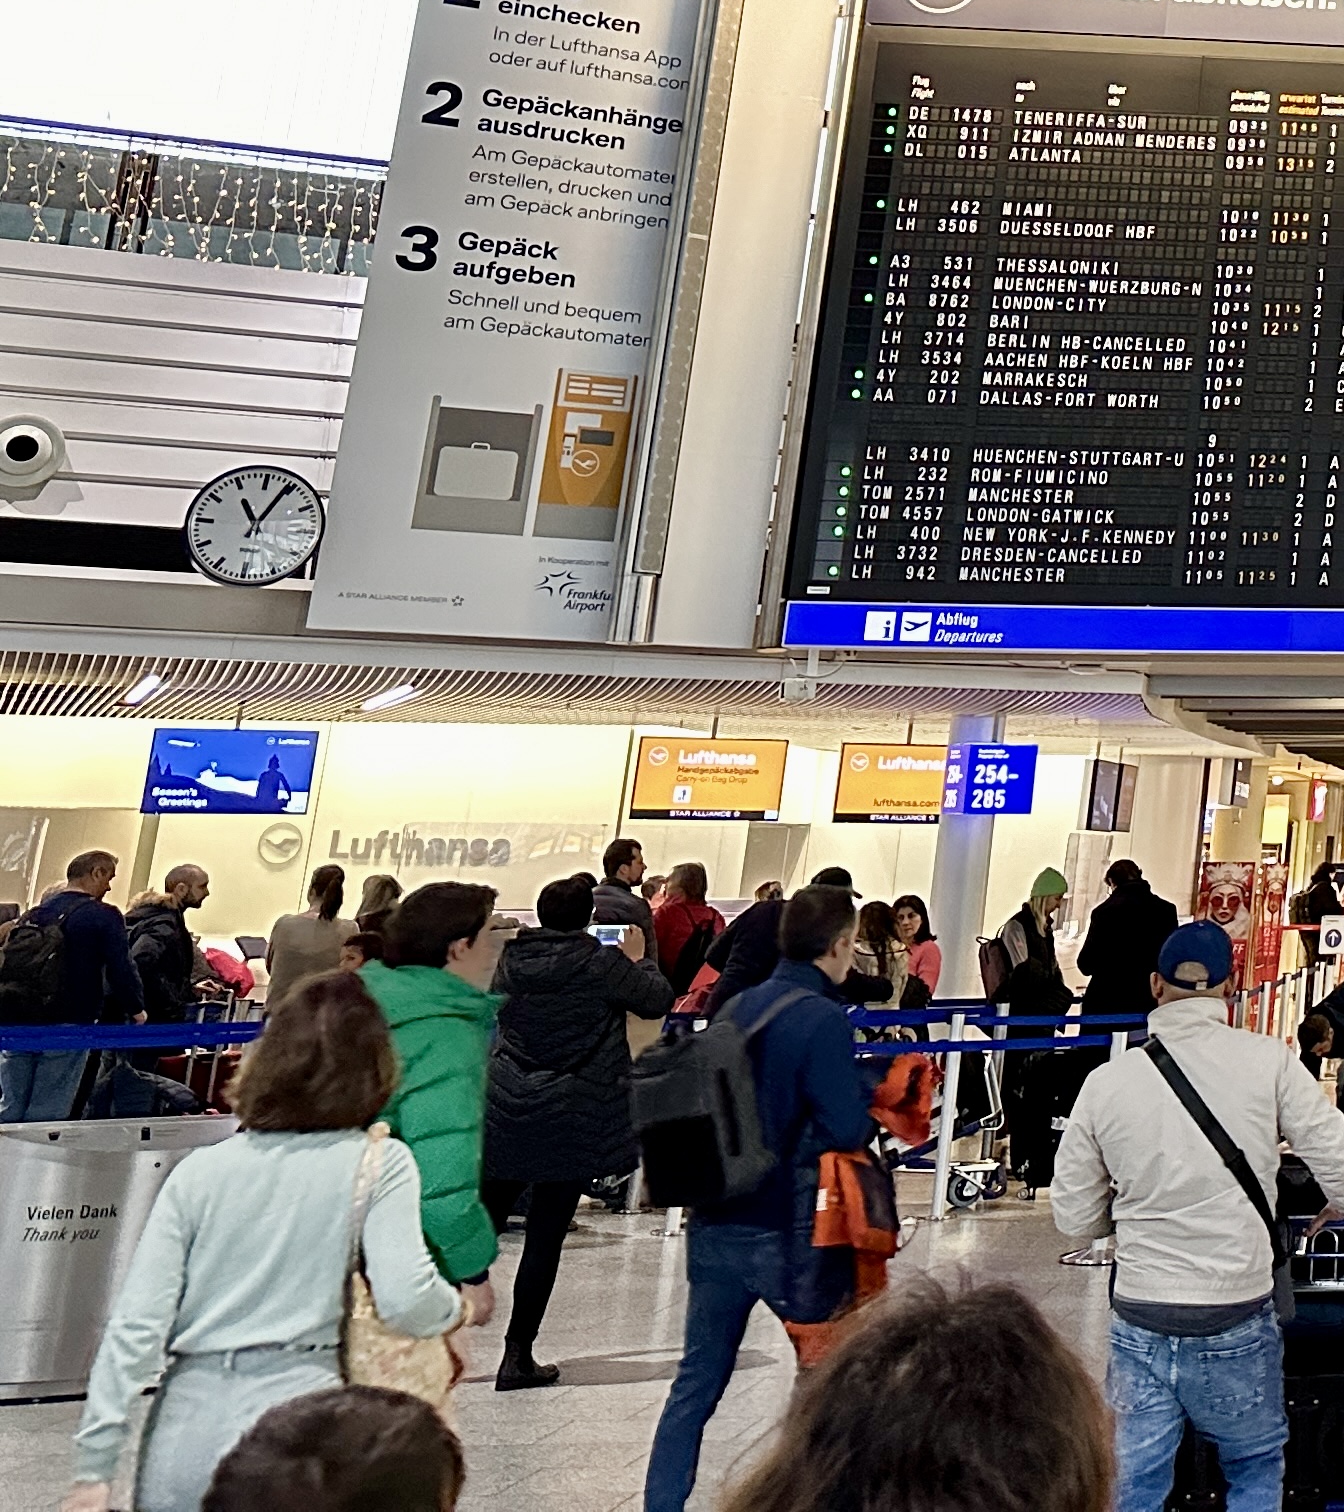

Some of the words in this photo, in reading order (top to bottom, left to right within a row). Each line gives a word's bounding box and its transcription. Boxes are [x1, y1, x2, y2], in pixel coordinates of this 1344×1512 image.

[498, 0, 641, 34] einchecken
[493, 26, 509, 42] In
[515, 30, 546, 47] der
[550, 36, 640, 62] Lufthansa
[644, 50, 682, 70] App
[489, 51, 533, 68] oder
[536, 59, 567, 73] auf
[421, 81, 463, 128] 2
[482, 89, 683, 134] Gepäckanhänge
[1014, 110, 1147, 130] TENERIFFA-SUR
[478, 117, 625, 150] ausdrucken
[472, 145, 506, 163] Am
[1009, 149, 1081, 163] ATLANTA
[469, 170, 552, 193] erstellen,
[558, 180, 632, 202] drucken
[638, 192, 672, 207] und
[464, 194, 494, 208] am
[500, 195, 572, 218] Gepäck
[578, 206, 669, 229] anbringen
[395, 226, 439, 272] 3
[458, 232, 560, 260] Gepäck
[452, 260, 576, 288] aufgeben
[997, 258, 1119, 276] THESSALONIKI
[448, 290, 518, 311] Schnell
[524, 299, 560, 316] und
[564, 304, 641, 324] bequem
[992, 295, 1106, 312] LONDON-CITY
[444, 316, 474, 330] am
[982, 373, 1088, 388] MARRAKESCH
[860, 505, 890, 520] TOM
[902, 506, 944, 521] 4557
[967, 508, 1115, 524] LONDON-GATWICK
[959, 566, 1065, 583] MANCHESTER
[564, 600, 606, 613] Airport
[936, 613, 978, 628] Abflug
[934, 630, 1003, 644] Departures
[678, 749, 757, 765] Lufthansa
[878, 756, 946, 771] Lufthans
[873, 798, 940, 808] lufthansa.com
[971, 789, 1005, 808] 285
[329, 829, 511, 866] Lufthansa
[28, 1206, 74, 1220] Vielen
[80, 1204, 117, 1218] Dank
[22, 1227, 68, 1241] Thank
[70, 1228, 100, 1244] you
